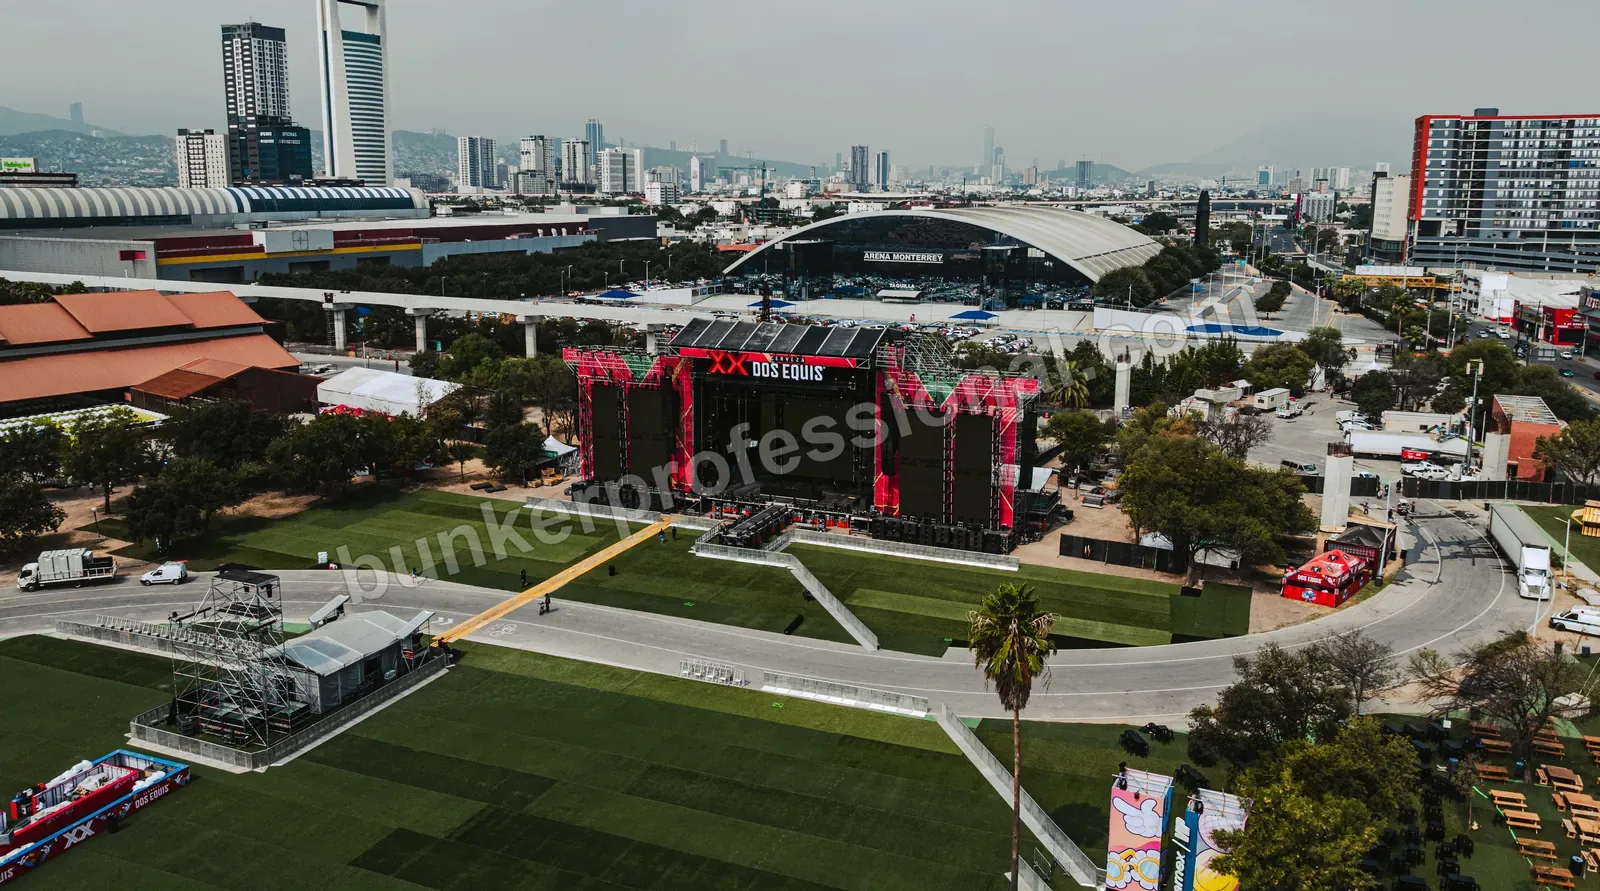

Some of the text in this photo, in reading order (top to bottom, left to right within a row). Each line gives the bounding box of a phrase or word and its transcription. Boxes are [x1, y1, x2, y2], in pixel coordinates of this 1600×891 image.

[864, 251, 943, 262] ARENA MONTERREY
[709, 350, 749, 376] XX
[752, 361, 824, 381] DOS EQUIS
[135, 795, 149, 809] DOS
[149, 784, 170, 801] EQUIS
[63, 819, 95, 850] XX
